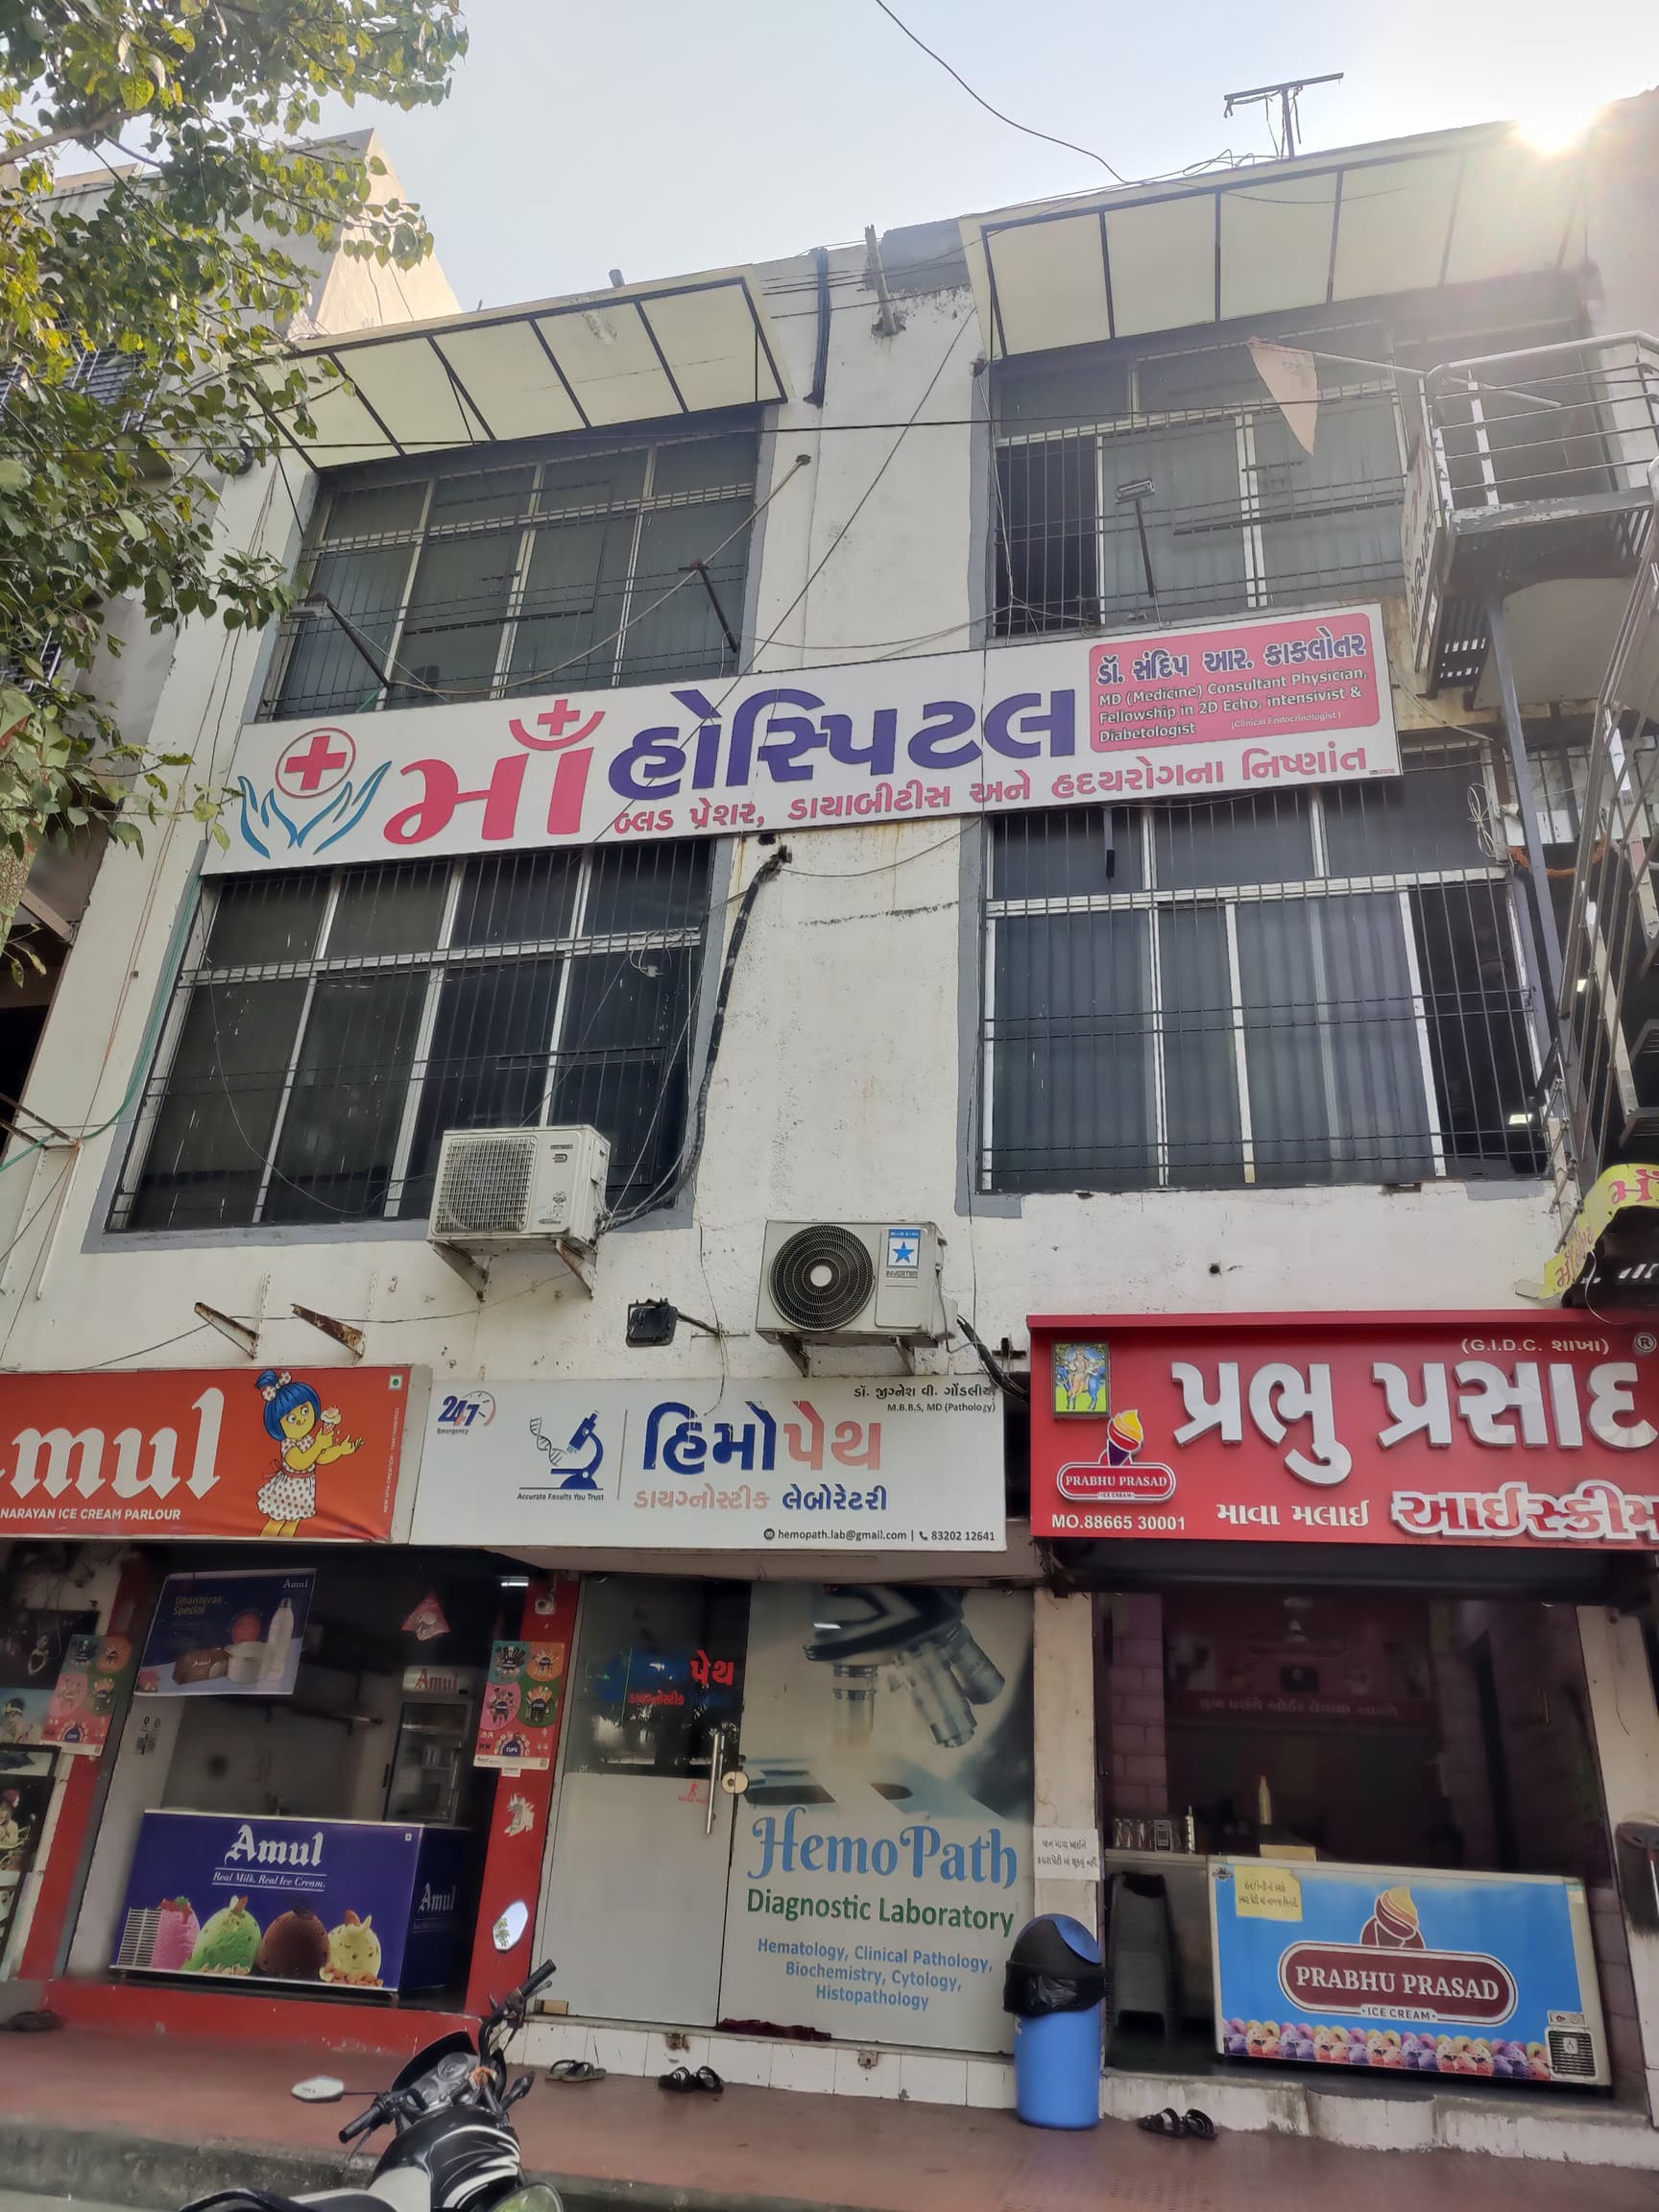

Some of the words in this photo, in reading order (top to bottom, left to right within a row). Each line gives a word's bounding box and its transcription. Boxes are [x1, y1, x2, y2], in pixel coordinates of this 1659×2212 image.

[1133, 649, 1190, 681] સંદિપ
[1204, 648, 1255, 672] આર.
[1264, 626, 1366, 666] કાકલોતર
[1099, 694, 1121, 706] MD
[1127, 685, 1202, 706] (Medicine)
[1208, 676, 1287, 695] Consultant
[1292, 669, 1367, 686] Physician,
[1099, 706, 1176, 724] Fellowship
[1181, 704, 1193, 716] in
[1199, 702, 1218, 714] 2D
[1224, 698, 1262, 711] Echo,
[1267, 687, 1345, 708] intensivist
[1351, 685, 1362, 698] &
[1099, 722, 1195, 743] Diabetologist
[1231, 718, 1266, 729] (Clinical
[1268, 711, 1336, 724] Endocrinologist
[609, 688, 1076, 801] હોસ્પિટલ
[787, 780, 950, 820] ડાયાબીટીસ
[970, 769, 1031, 804] અને
[1461, 1337, 1543, 1355] (G.I.D.C.
[1551, 1338, 1610, 1355] શાખા)
[1170, 1360, 1353, 1487] પ્રભુ
[1372, 1359, 1659, 1450] પ્રસાદ
[0, 1387, 225, 1500] mul
[1066, 1476, 1116, 1486] PRABHU
[1119, 1476, 1167, 1487] PRASAD
[782, 1483, 887, 1510] લેબોરેટરી
[0, 1508, 55, 1520] NARAYAN
[59, 1508, 77, 1520] ICE
[81, 1508, 121, 1520] CREAM
[125, 1508, 181, 1521] PARLOUR
[1051, 1514, 1133, 1529] MO.88665
[1138, 1515, 1186, 1530] 30001
[1215, 1503, 1281, 1526] માવા
[1291, 1500, 1370, 1527] મલાઈ
[778, 1529, 906, 1542] hemopath.lab@gmail.com
[931, 1530, 962, 1541] 83202
[965, 1530, 996, 1541] 12641
[225, 1824, 324, 1866] Amul
[213, 1871, 234, 1882] Real
[258, 1874, 279, 1885] Real
[279, 1875, 293, 1886] Ice
[747, 1887, 871, 1921] Diagnostic
[878, 1897, 1014, 1937] Laboratory
[757, 1937, 850, 1962] Hematology,
[854, 1945, 907, 1964] Clinical
[913, 1950, 993, 1974] Pathology,
[785, 1961, 886, 1985] Biochemistry,
[892, 1969, 962, 1992] Cytology,
[1295, 1965, 1395, 1993] PRABHU
[1402, 1974, 1500, 2001] PRASAD
[816, 1984, 929, 2012] Histopathology
[1367, 2008, 1386, 2017] ICE
[1389, 2008, 1431, 2020] CREAM
